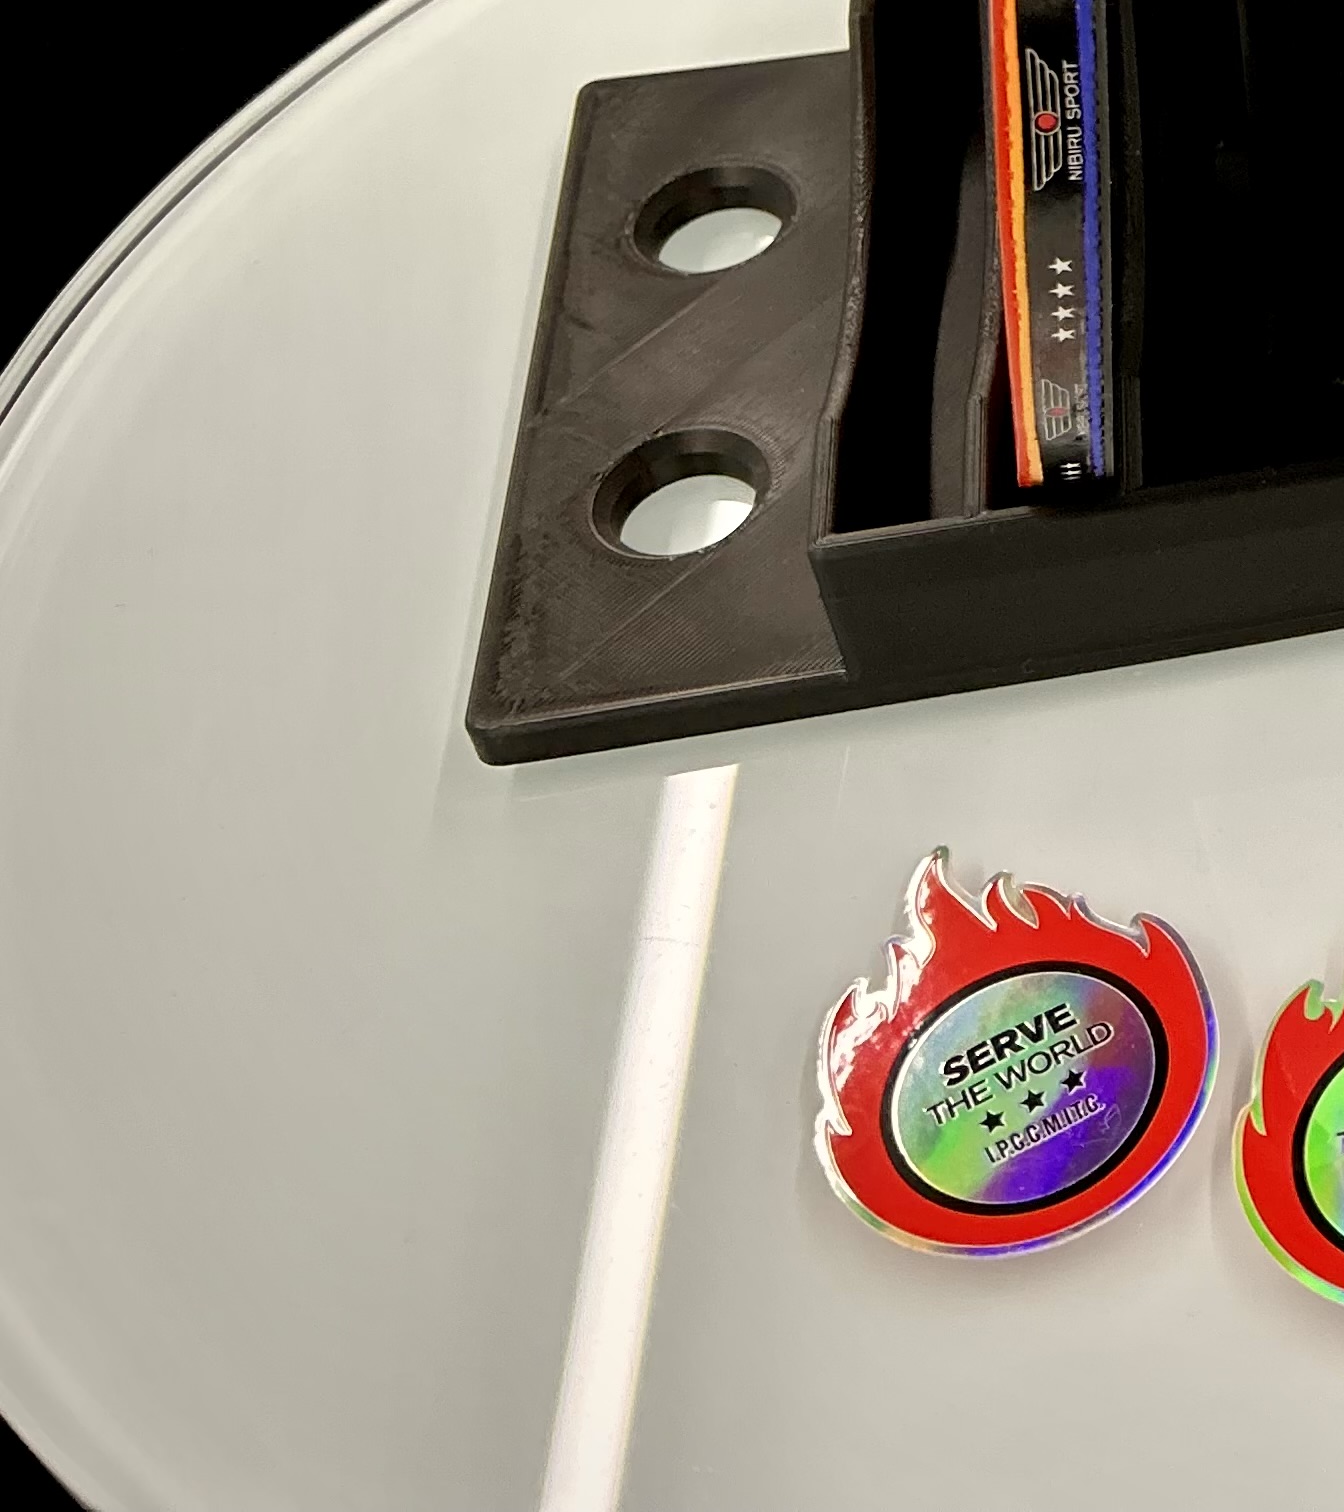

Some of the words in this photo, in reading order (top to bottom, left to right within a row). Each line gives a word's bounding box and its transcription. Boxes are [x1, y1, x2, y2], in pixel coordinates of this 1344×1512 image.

[1061, 59, 1081, 120] SPORT
[1065, 126, 1083, 181] NIBIRU
[924, 1079, 995, 1126] THE
[992, 1021, 1114, 1091] WORLD
[942, 1002, 1079, 1087] SERVE
